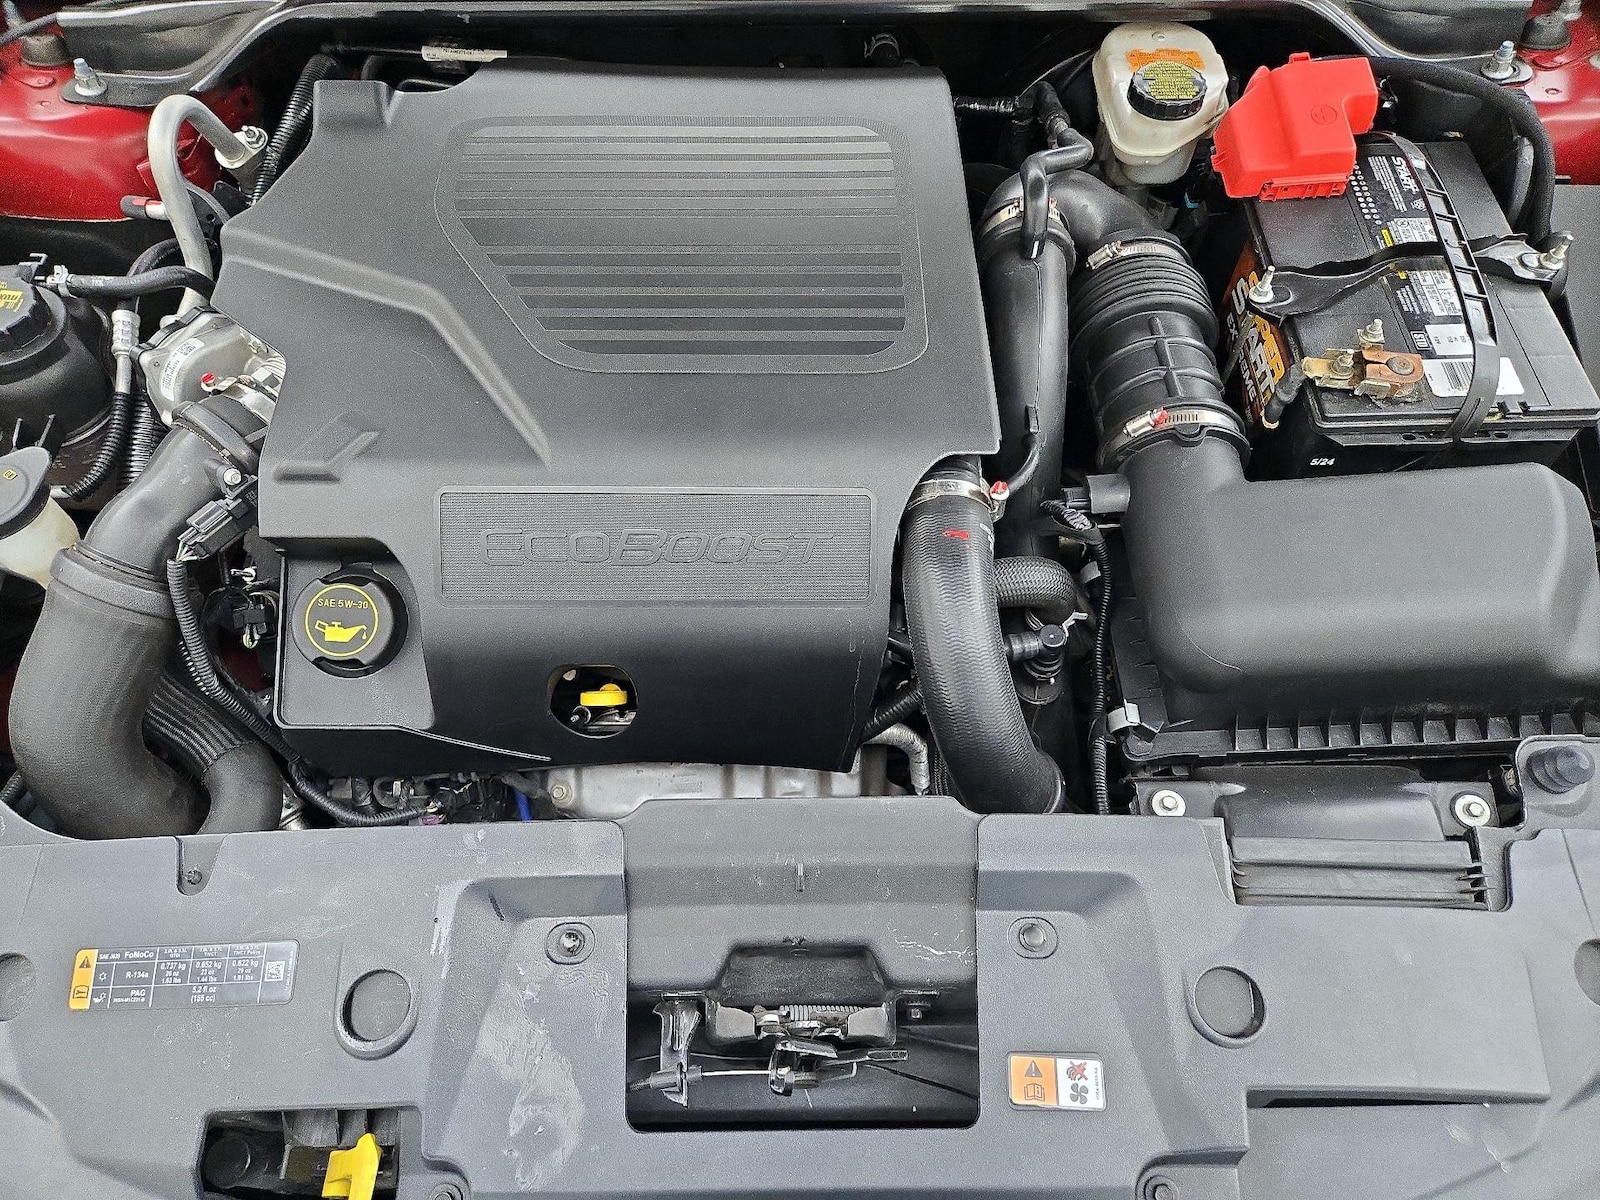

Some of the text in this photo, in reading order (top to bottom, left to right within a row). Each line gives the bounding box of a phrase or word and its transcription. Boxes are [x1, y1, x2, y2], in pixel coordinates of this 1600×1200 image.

[1226, 312, 1257, 402] EXREME
[1310, 457, 1335, 466] 5/24
[317, 598, 369, 609] SAE 5W-30
[124, 950, 154, 959] FoMoCo
[160, 962, 186, 971] 0.737 kg
[195, 961, 222, 970] 0.652 kg
[251, 959, 259, 968] kg
[126, 971, 149, 979] R-134a
[130, 989, 146, 997] PAG
[191, 986, 202, 994] 5.2
[190, 994, 216, 1004] (155 cc)
